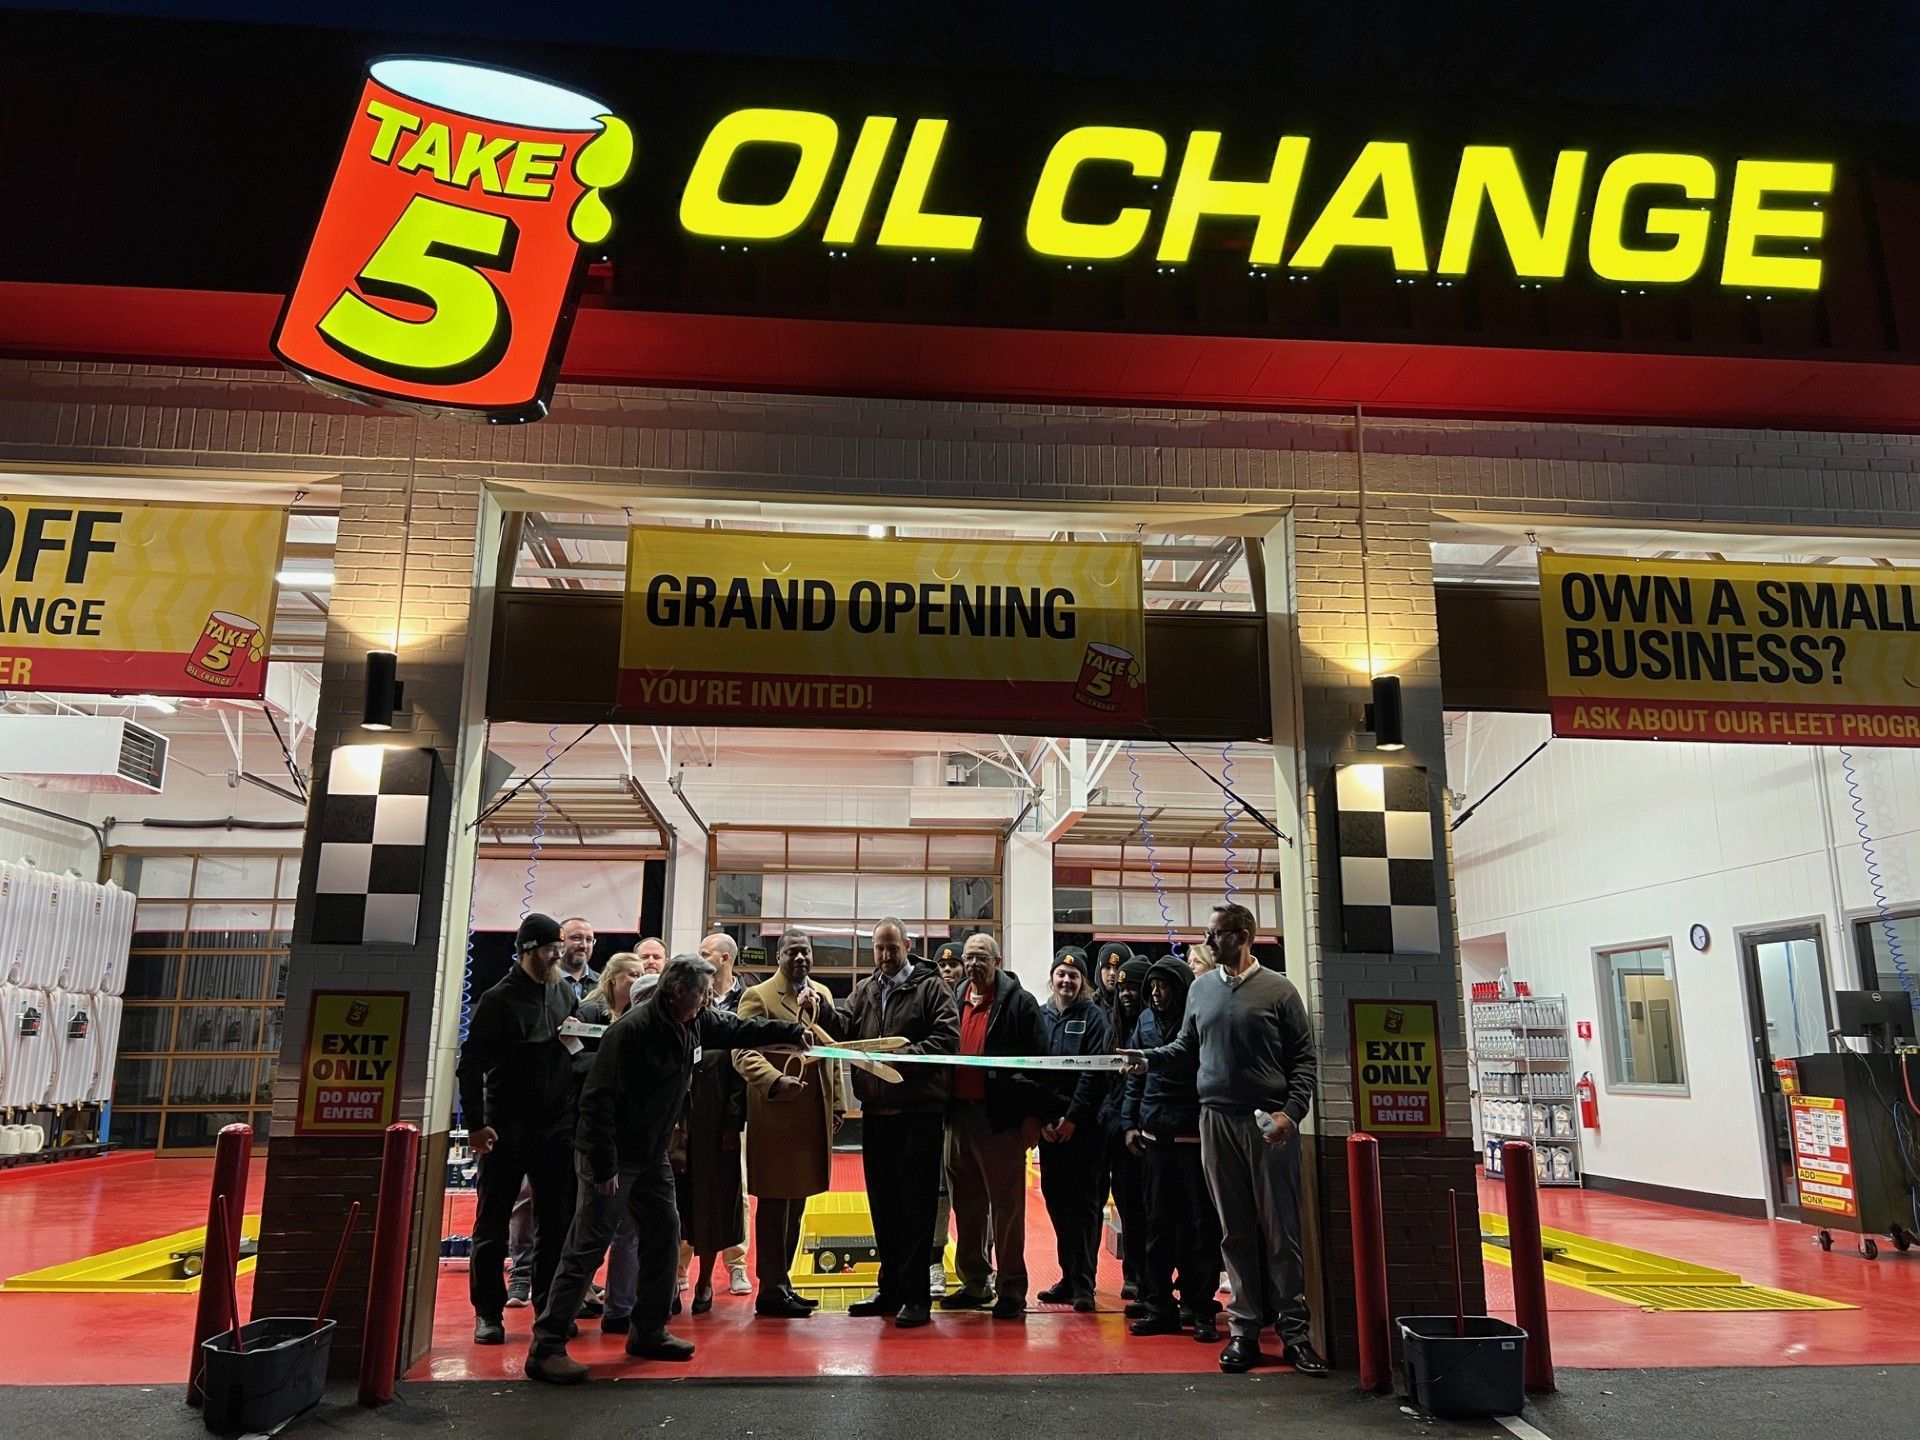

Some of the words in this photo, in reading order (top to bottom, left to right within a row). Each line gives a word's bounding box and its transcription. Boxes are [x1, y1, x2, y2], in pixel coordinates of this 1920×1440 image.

[366, 99, 564, 200] TAKE
[680, 108, 982, 250] OIL
[1026, 126, 1833, 289] CHANGE
[317, 193, 516, 380] 5
[646, 574, 836, 632] GRAND
[847, 580, 1077, 640] OPENING
[1561, 572, 1693, 625] OWN
[1707, 579, 1746, 626] A
[1756, 580, 1920, 632] SMALL
[0, 597, 106, 636] NGE
[205, 620, 250, 648] TAKE
[201, 643, 234, 671] 5
[1086, 650, 1126, 676] TAKE
[1565, 627, 1847, 686] BUSINESS?
[187, 665, 198, 676] OIL
[200, 672, 230, 685] CHANGE
[1086, 672, 1112, 697] 5
[640, 677, 741, 706] YOU'RE
[751, 680, 873, 710] INVITED!
[1573, 706, 1621, 730] ASK
[1627, 708, 1708, 732] ABOUT
[1714, 710, 1765, 734] OUR
[1769, 711, 1836, 736] FLEET
[322, 1034, 389, 1055] EXIT
[1366, 1041, 1426, 1061] EXIT
[312, 1058, 392, 1081] ONLY
[1362, 1064, 1432, 1085] ONLY
[319, 1091, 342, 1104] DO
[347, 1091, 381, 1104] NOT
[1372, 1095, 1392, 1106] DO
[1397, 1095, 1427, 1107] NOT
[1791, 1096, 1807, 1105] PICK
[322, 1107, 374, 1119] ENTER
[1378, 1110, 1424, 1122] ENTER
[1800, 1170, 1816, 1179] ADD
[1802, 1194, 1823, 1205] HONK
